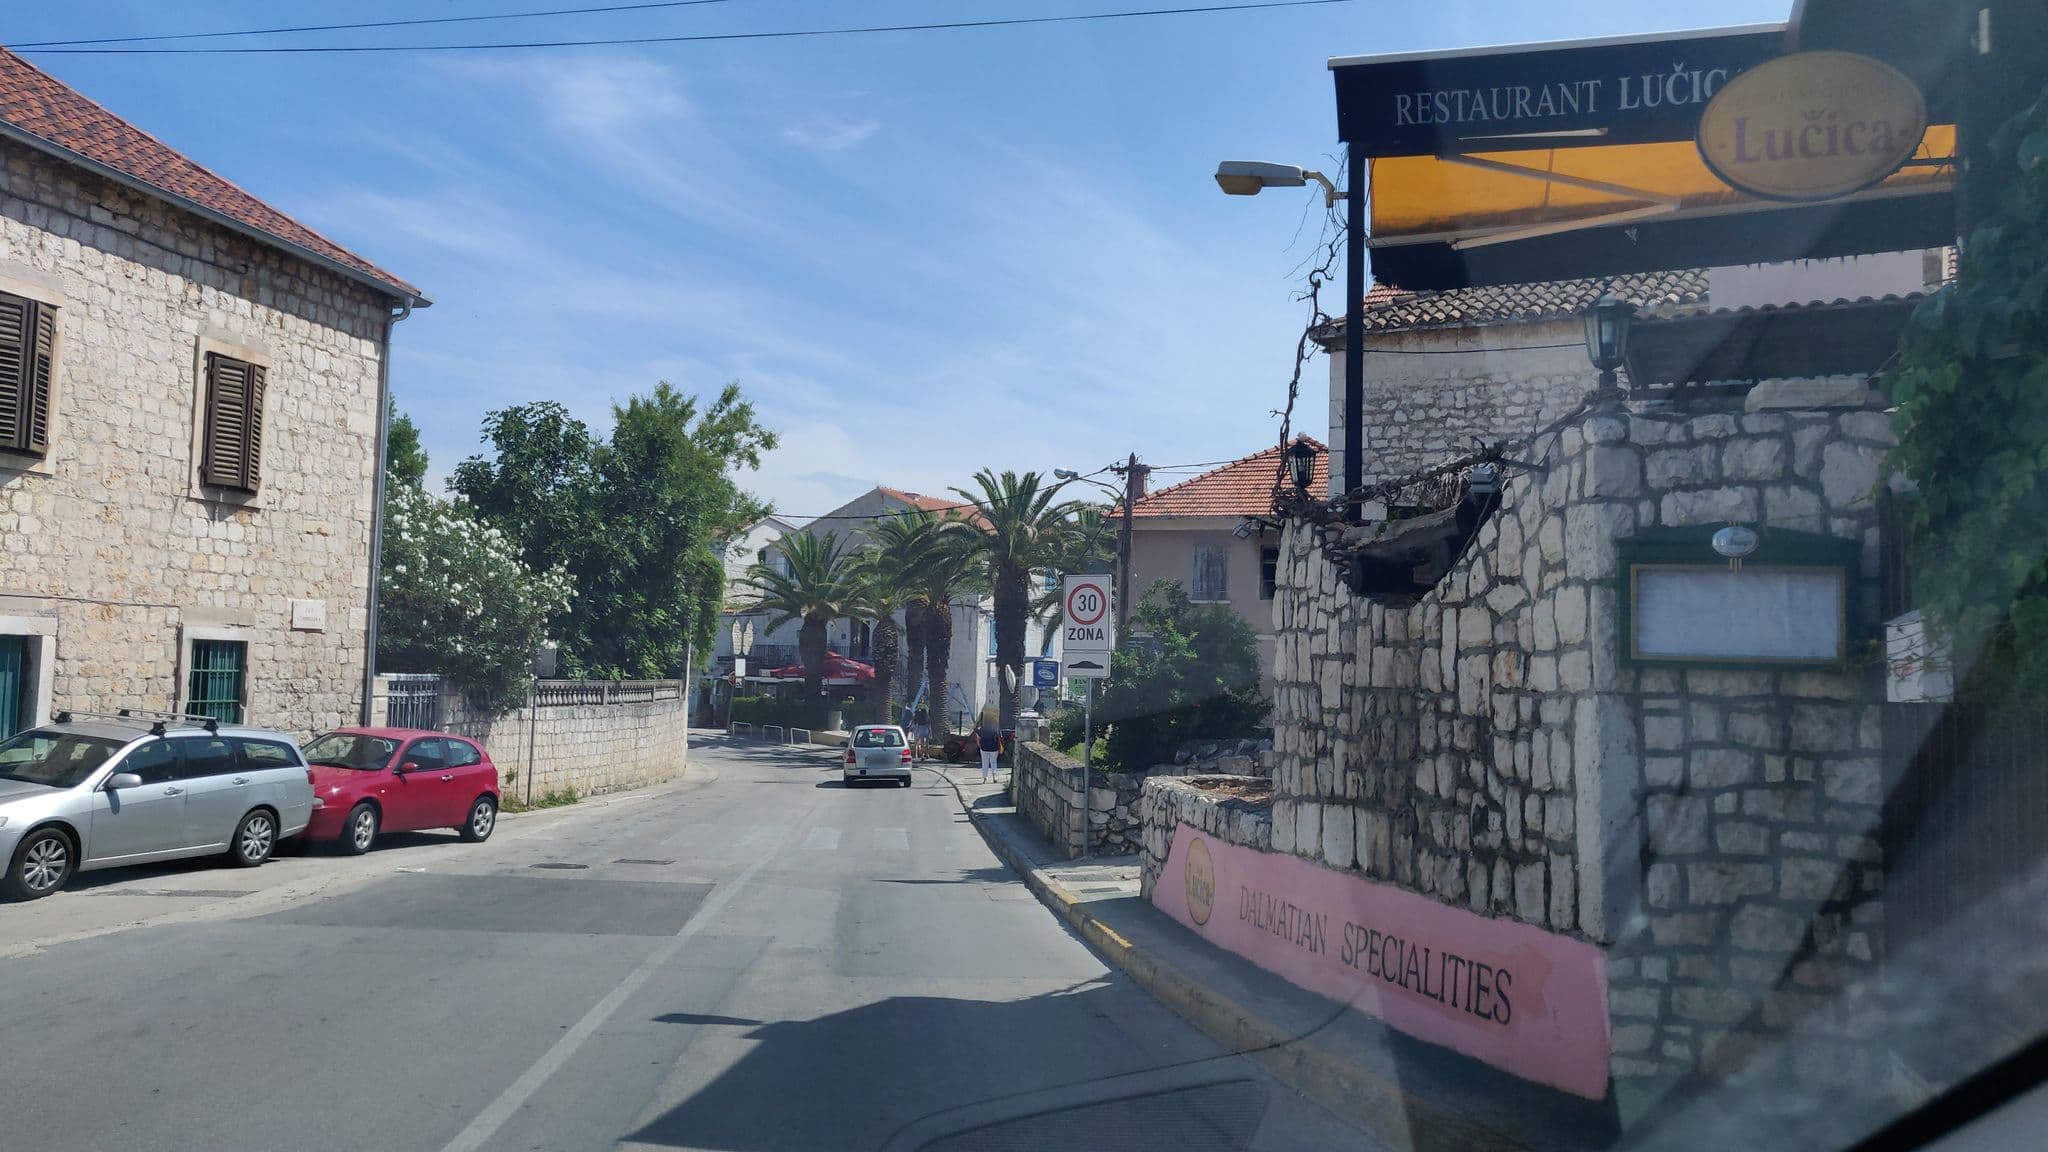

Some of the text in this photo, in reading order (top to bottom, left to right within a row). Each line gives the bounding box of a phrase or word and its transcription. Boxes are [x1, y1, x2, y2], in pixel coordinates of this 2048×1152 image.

[1395, 79, 1602, 126] RESTAURANT
[1617, 61, 1730, 110] LUČIC
[1078, 594, 1097, 612] 30
[1068, 628, 1104, 640] ZONA
[1239, 885, 1513, 1026] DALMATIAN SPECIALITIES
